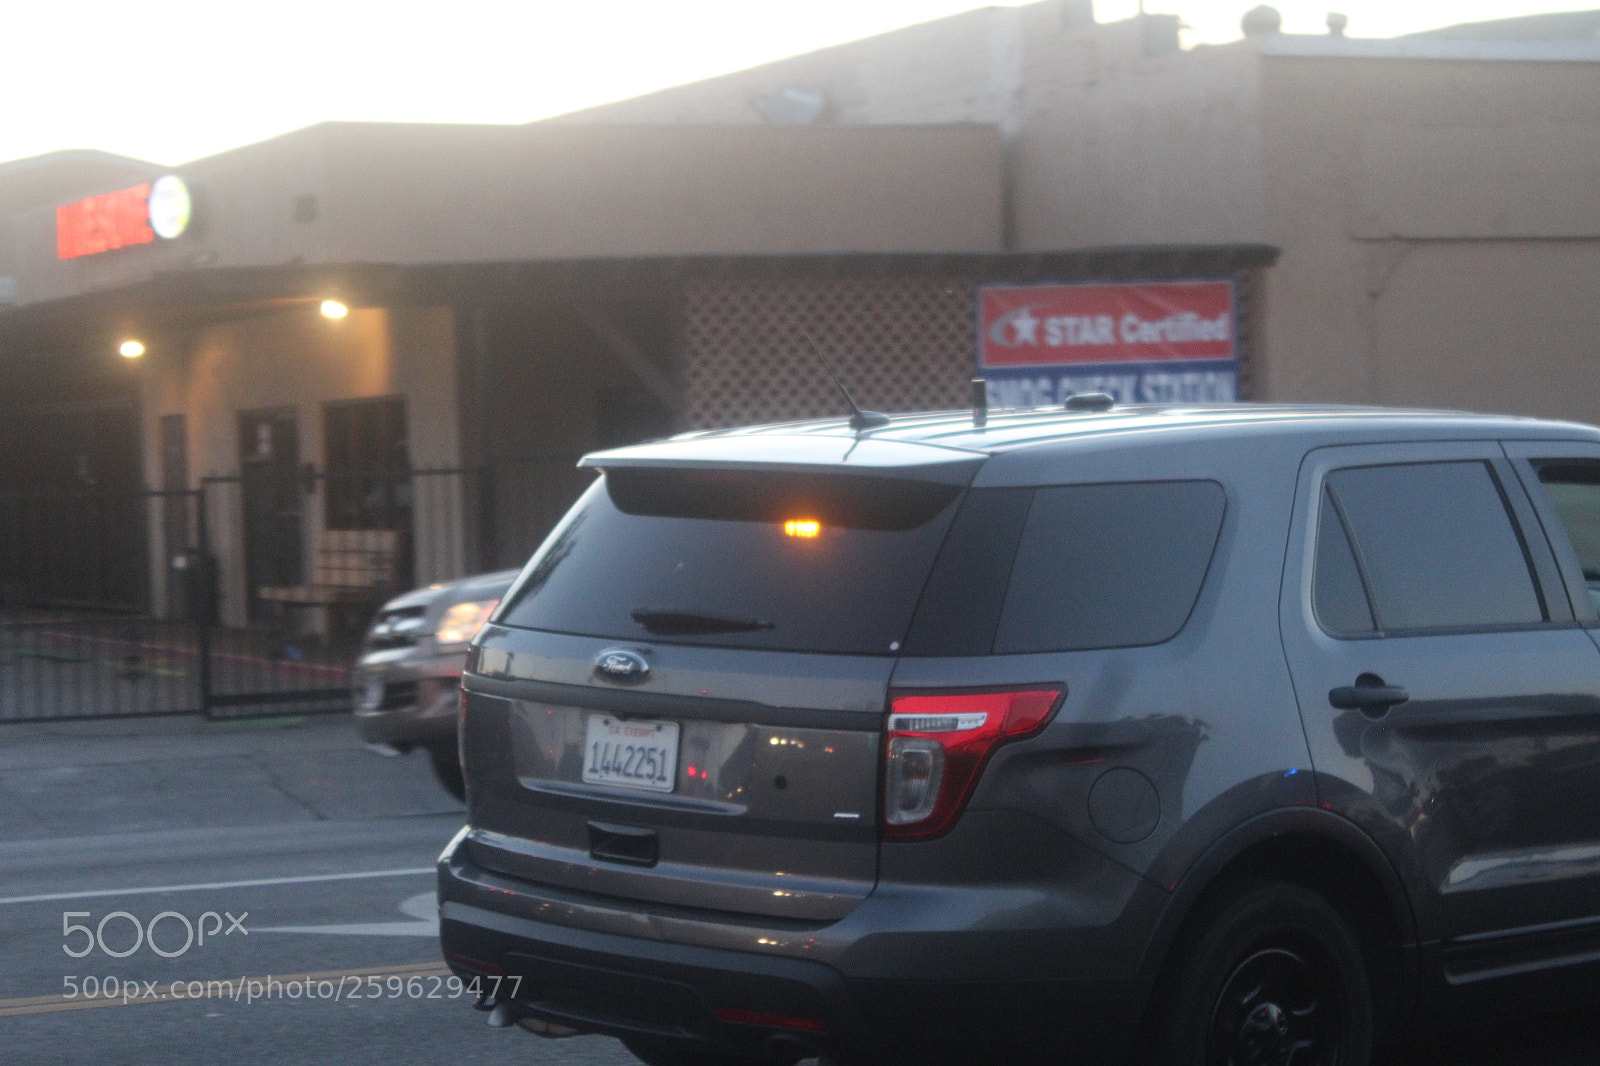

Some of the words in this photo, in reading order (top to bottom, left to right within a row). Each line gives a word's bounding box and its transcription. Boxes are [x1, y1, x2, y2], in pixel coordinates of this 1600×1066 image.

[1045, 315, 1115, 346] STAR
[1119, 311, 1230, 344] Certified
[603, 655, 634, 674] Ford
[588, 741, 668, 782] 1442251
